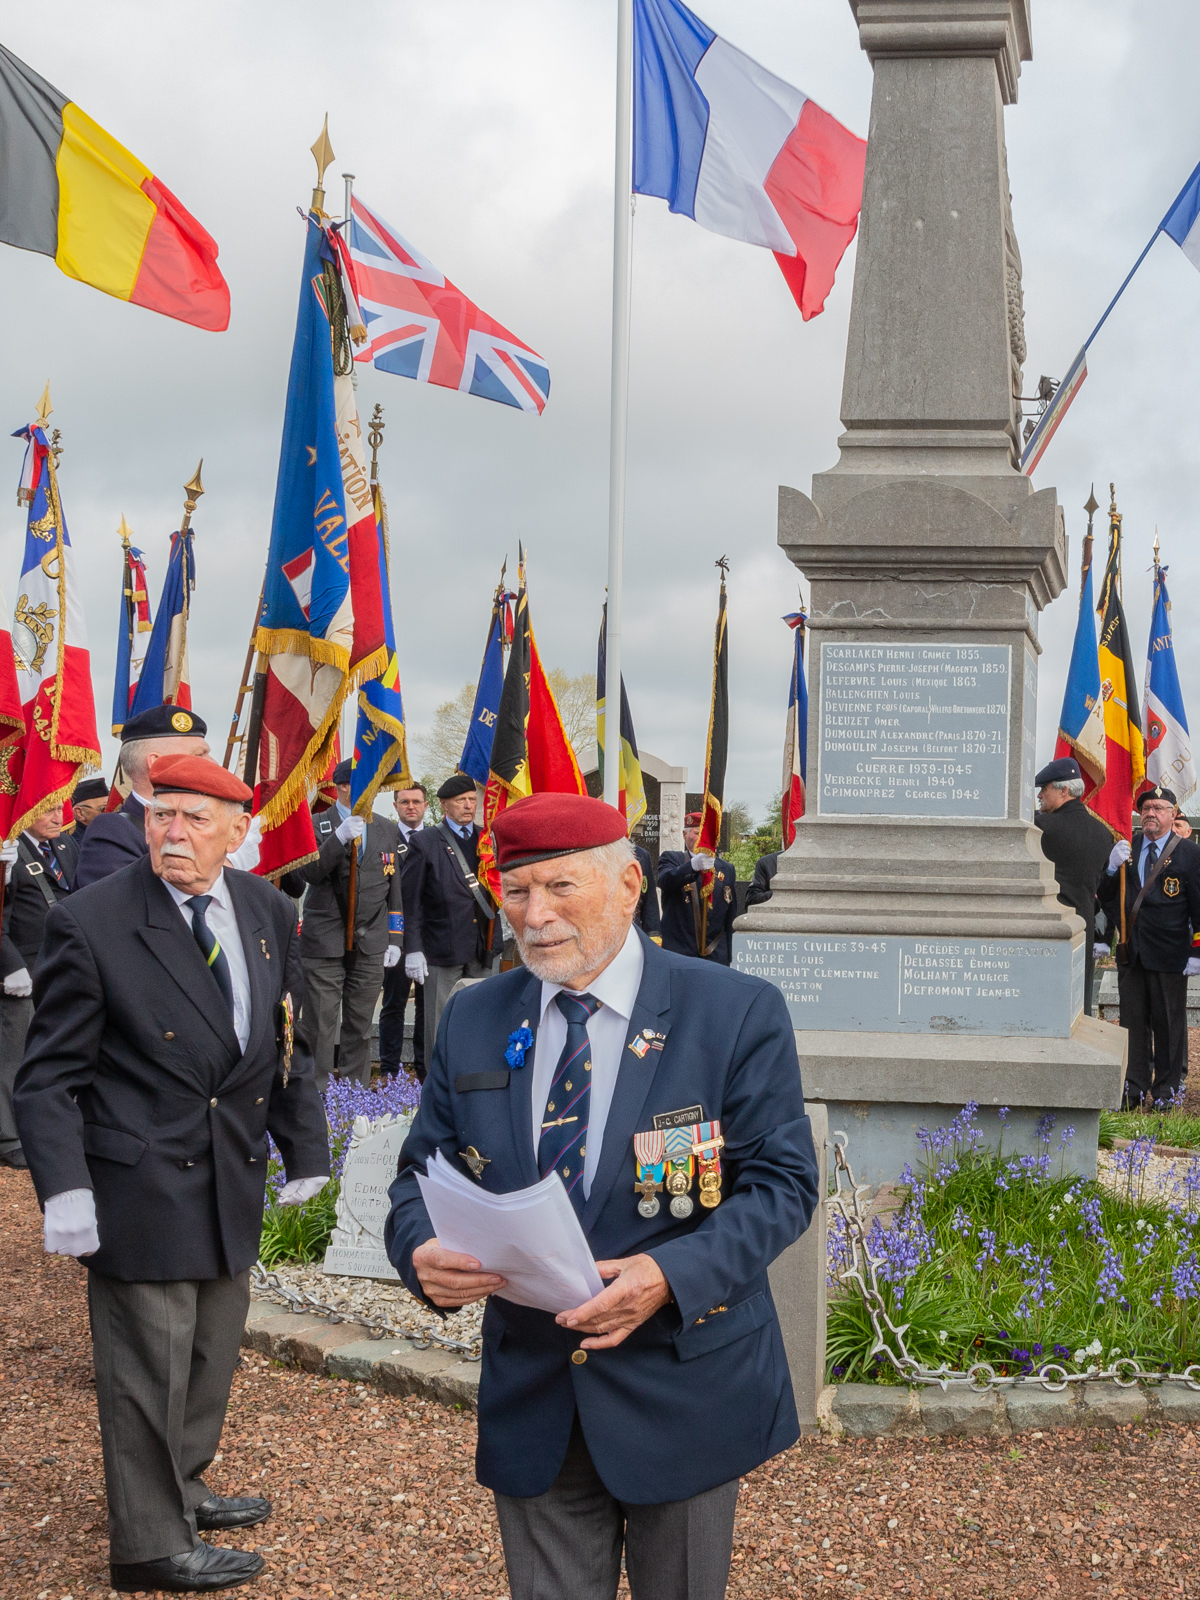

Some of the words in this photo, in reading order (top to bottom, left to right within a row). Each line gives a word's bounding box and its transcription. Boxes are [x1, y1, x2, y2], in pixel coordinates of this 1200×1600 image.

[826, 646, 884, 659] SCARLAKEN
[886, 649, 915, 659] HENRI
[826, 661, 876, 672] DESCAMPS
[826, 675, 876, 686] LEFEBVRE
[881, 676, 907, 686] LOUIS
[892, 690, 920, 700] LOUIS
[825, 701, 872, 712] DEVIENNE
[825, 713, 869, 726] BLEUZET
[874, 716, 901, 727] OMER
[825, 727, 878, 739] DUMOULIN
[880, 730, 934, 740] ALEXANDRE
[824, 740, 878, 752] DUMOULIN
[880, 743, 918, 753] JOSEPH
[856, 762, 905, 774] GUERRE
[909, 763, 973, 775] 1939-1945
[824, 773, 882, 786] VERBECKE
[888, 776, 920, 787] HENRI
[927, 776, 955, 787] 1940
[823, 785, 895, 798] GRIMONPREZ
[905, 789, 948, 799] GEORGES
[952, 789, 980, 800] 1942
[746, 939, 798, 951] VICTIMES
[803, 940, 847, 952] CIVILES
[850, 941, 887, 953] 39-45
[736, 951, 785, 964] GRARRE
[793, 954, 825, 965] LOUIS
[904, 954, 964, 968] DELBASSÉE
[814, 967, 880, 979] CLÉMENTINE
[904, 968, 958, 981] MOLHANT
[963, 971, 1010, 982] MAURICE
[780, 980, 823, 991] GASTON
[904, 982, 972, 995] DEFROMONT
[786, 992, 820, 1003] HENRI
[383, 1139, 390, 1150] A
[332, 1248, 370, 1260] HOMMAGE
[348, 1262, 385, 1274] SOUVENIR
